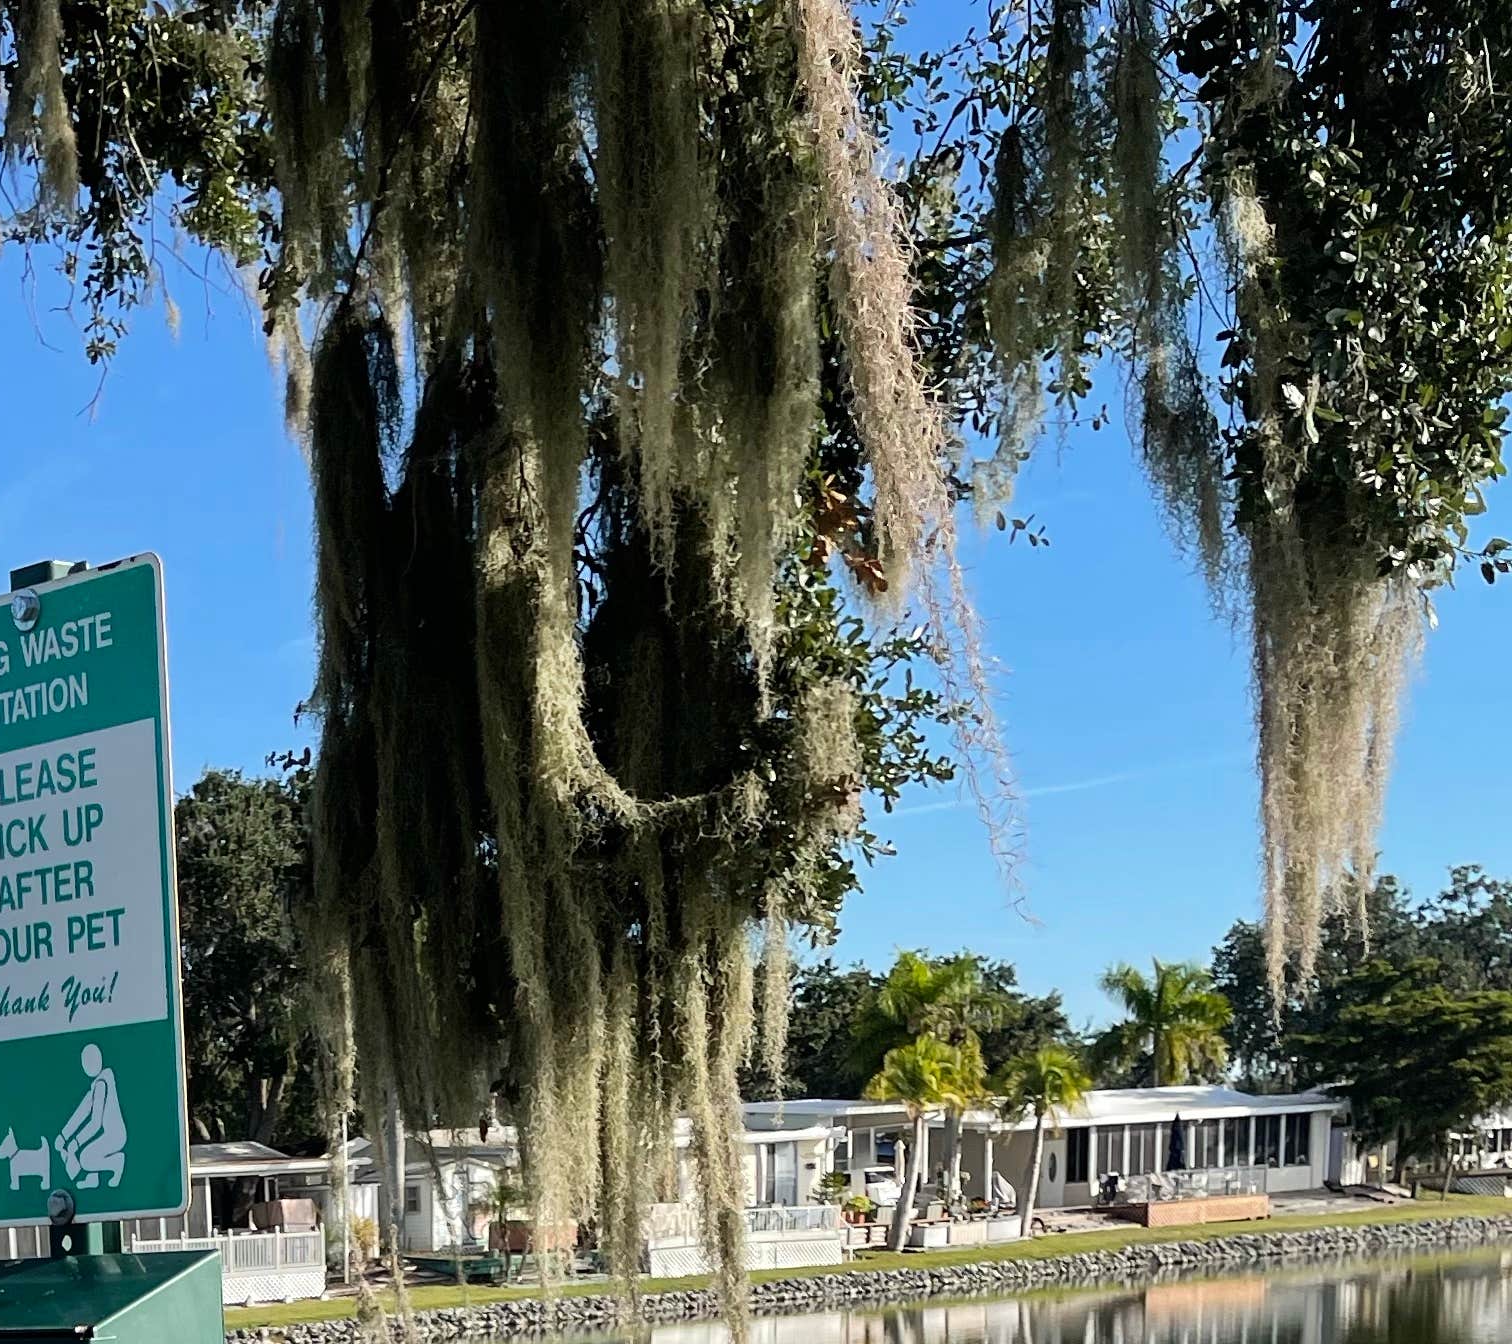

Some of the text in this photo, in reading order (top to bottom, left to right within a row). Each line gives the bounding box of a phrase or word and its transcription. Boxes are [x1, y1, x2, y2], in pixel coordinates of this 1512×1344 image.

[20, 612, 112, 667] WASTE
[63, 803, 103, 847] UP
[67, 908, 125, 954] PET
[61, 971, 119, 1023] You!
